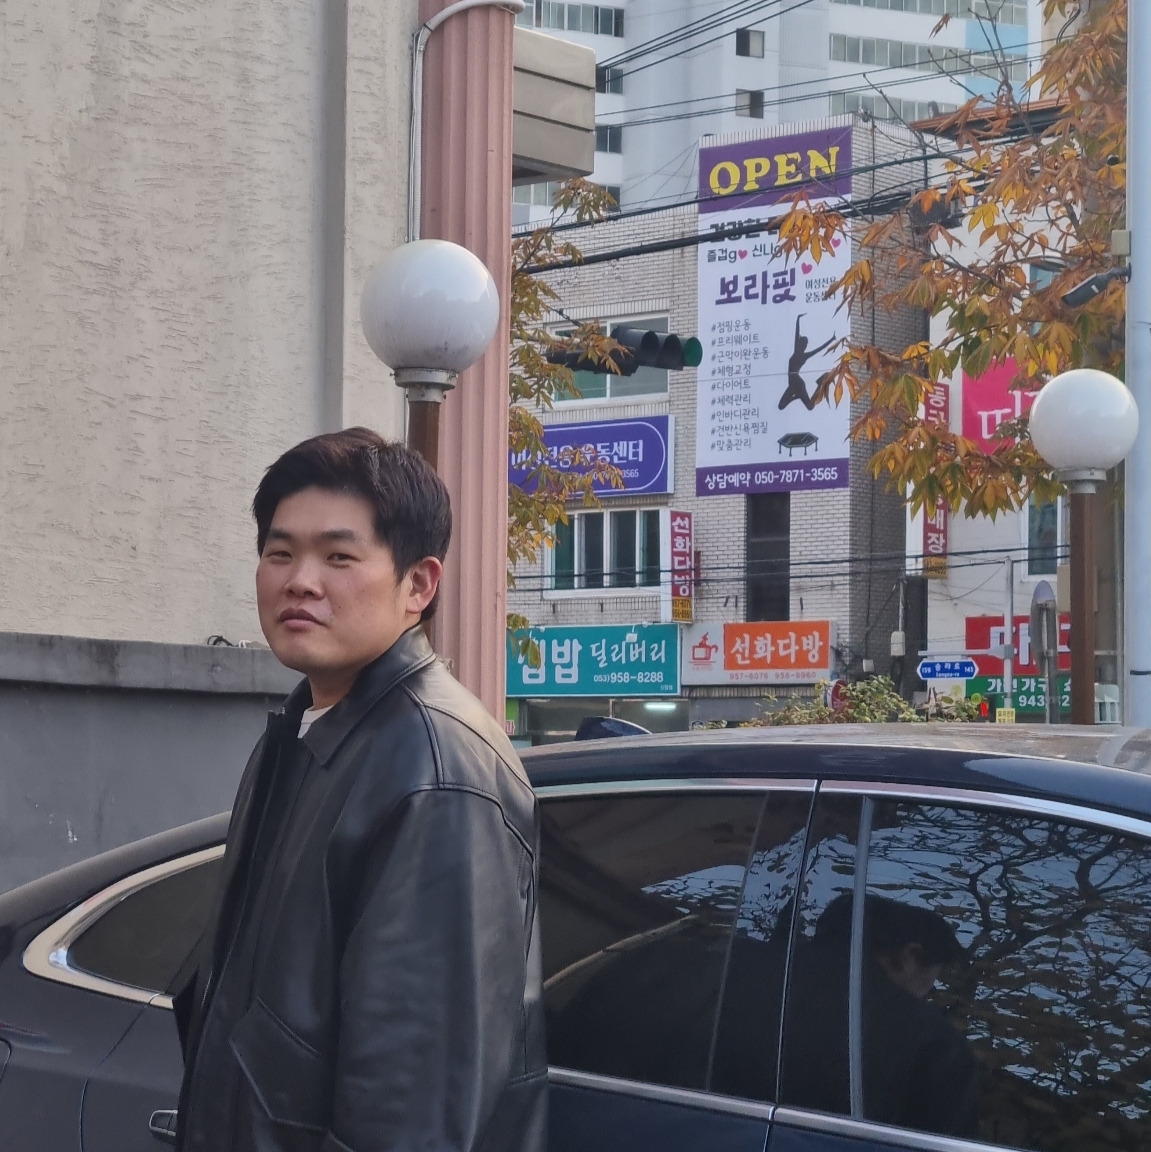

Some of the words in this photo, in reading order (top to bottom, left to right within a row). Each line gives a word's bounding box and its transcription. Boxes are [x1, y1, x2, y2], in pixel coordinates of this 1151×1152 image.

[709, 146, 840, 196] OPEN
[715, 267, 797, 306] 보라핏
[711, 319, 751, 334] #점핑운동
[711, 333, 761, 347] #프리웨이트
[711, 378, 751, 391] #다이어트
[711, 393, 751, 406] #체력관리
[711, 407, 760, 422] #인바디관리
[705, 471, 751, 490] 상담예약
[755, 467, 838, 485] 050-7871-3565
[672, 516, 691, 596] 선화다방
[590, 638, 666, 668] 딜리버리
[730, 630, 823, 665] 선화다방
